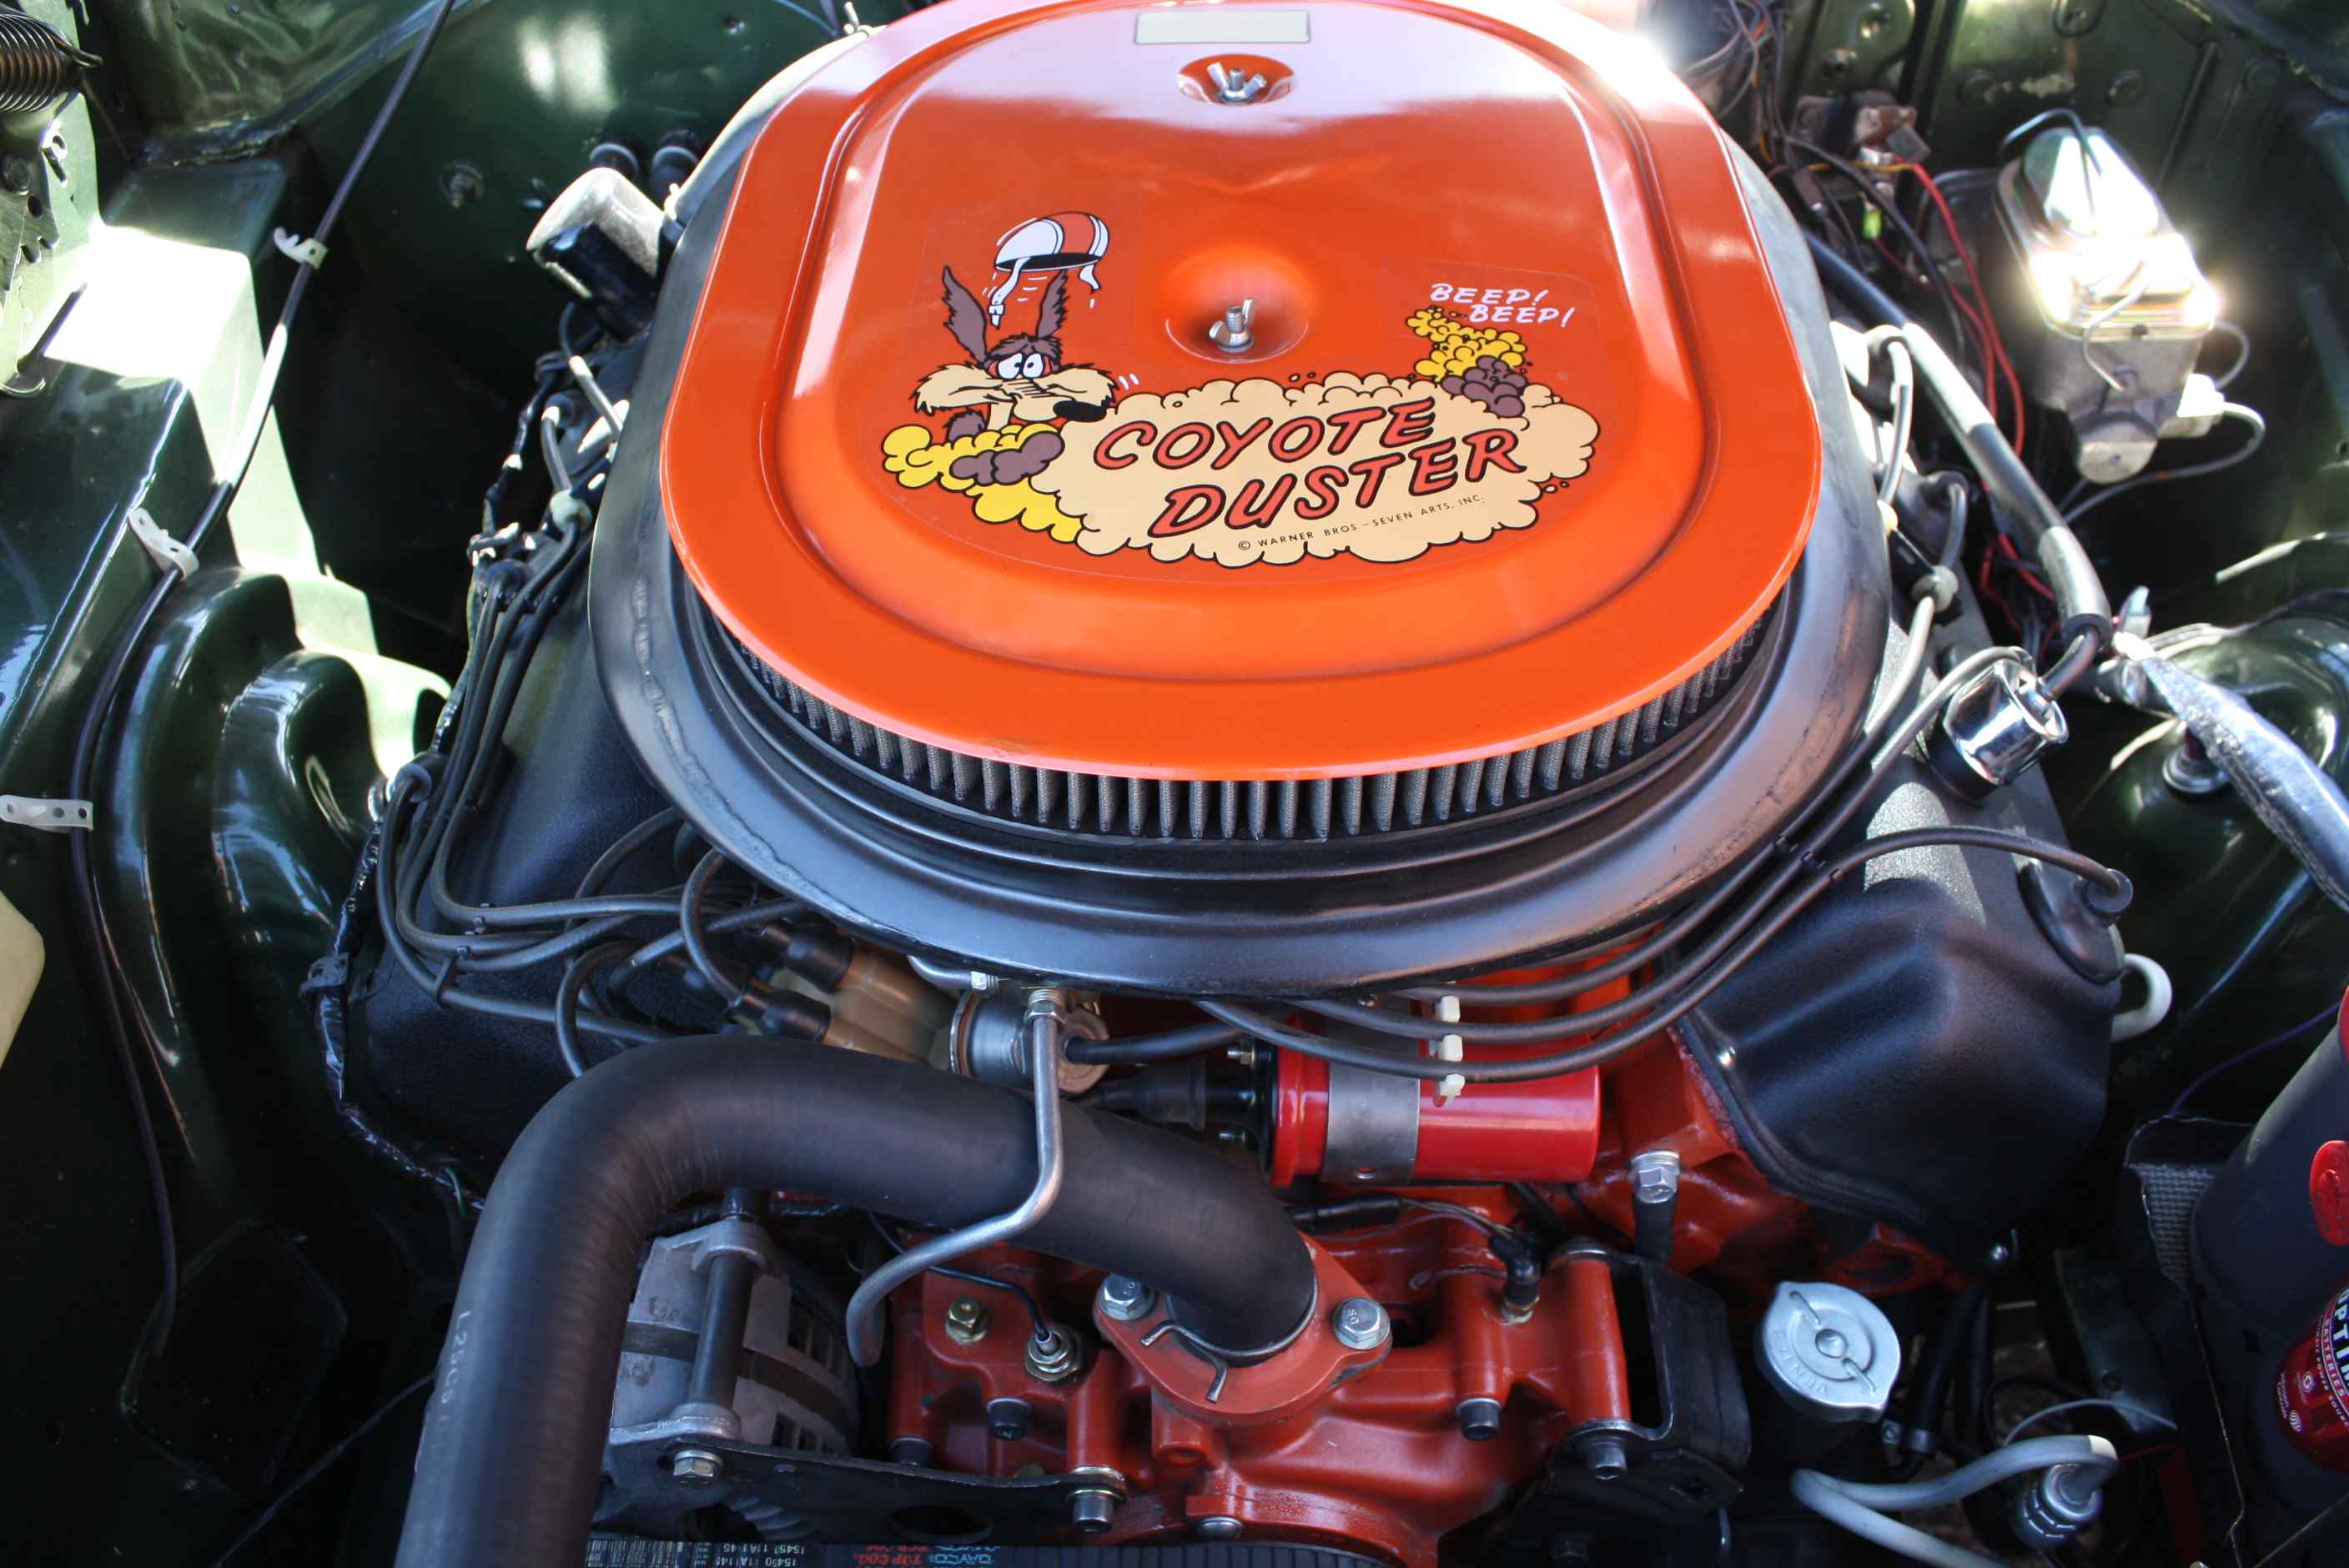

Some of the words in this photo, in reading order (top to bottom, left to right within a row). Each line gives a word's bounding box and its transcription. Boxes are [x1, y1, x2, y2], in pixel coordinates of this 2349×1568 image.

[1430, 282, 1549, 306] BEEP!
[1469, 304, 1576, 328] BEEP!
[1093, 396, 1436, 470] COYOTE
[1147, 428, 1527, 538] DUSTER
[1258, 531, 1314, 547] WARNER
[1324, 524, 1357, 536] BROS
